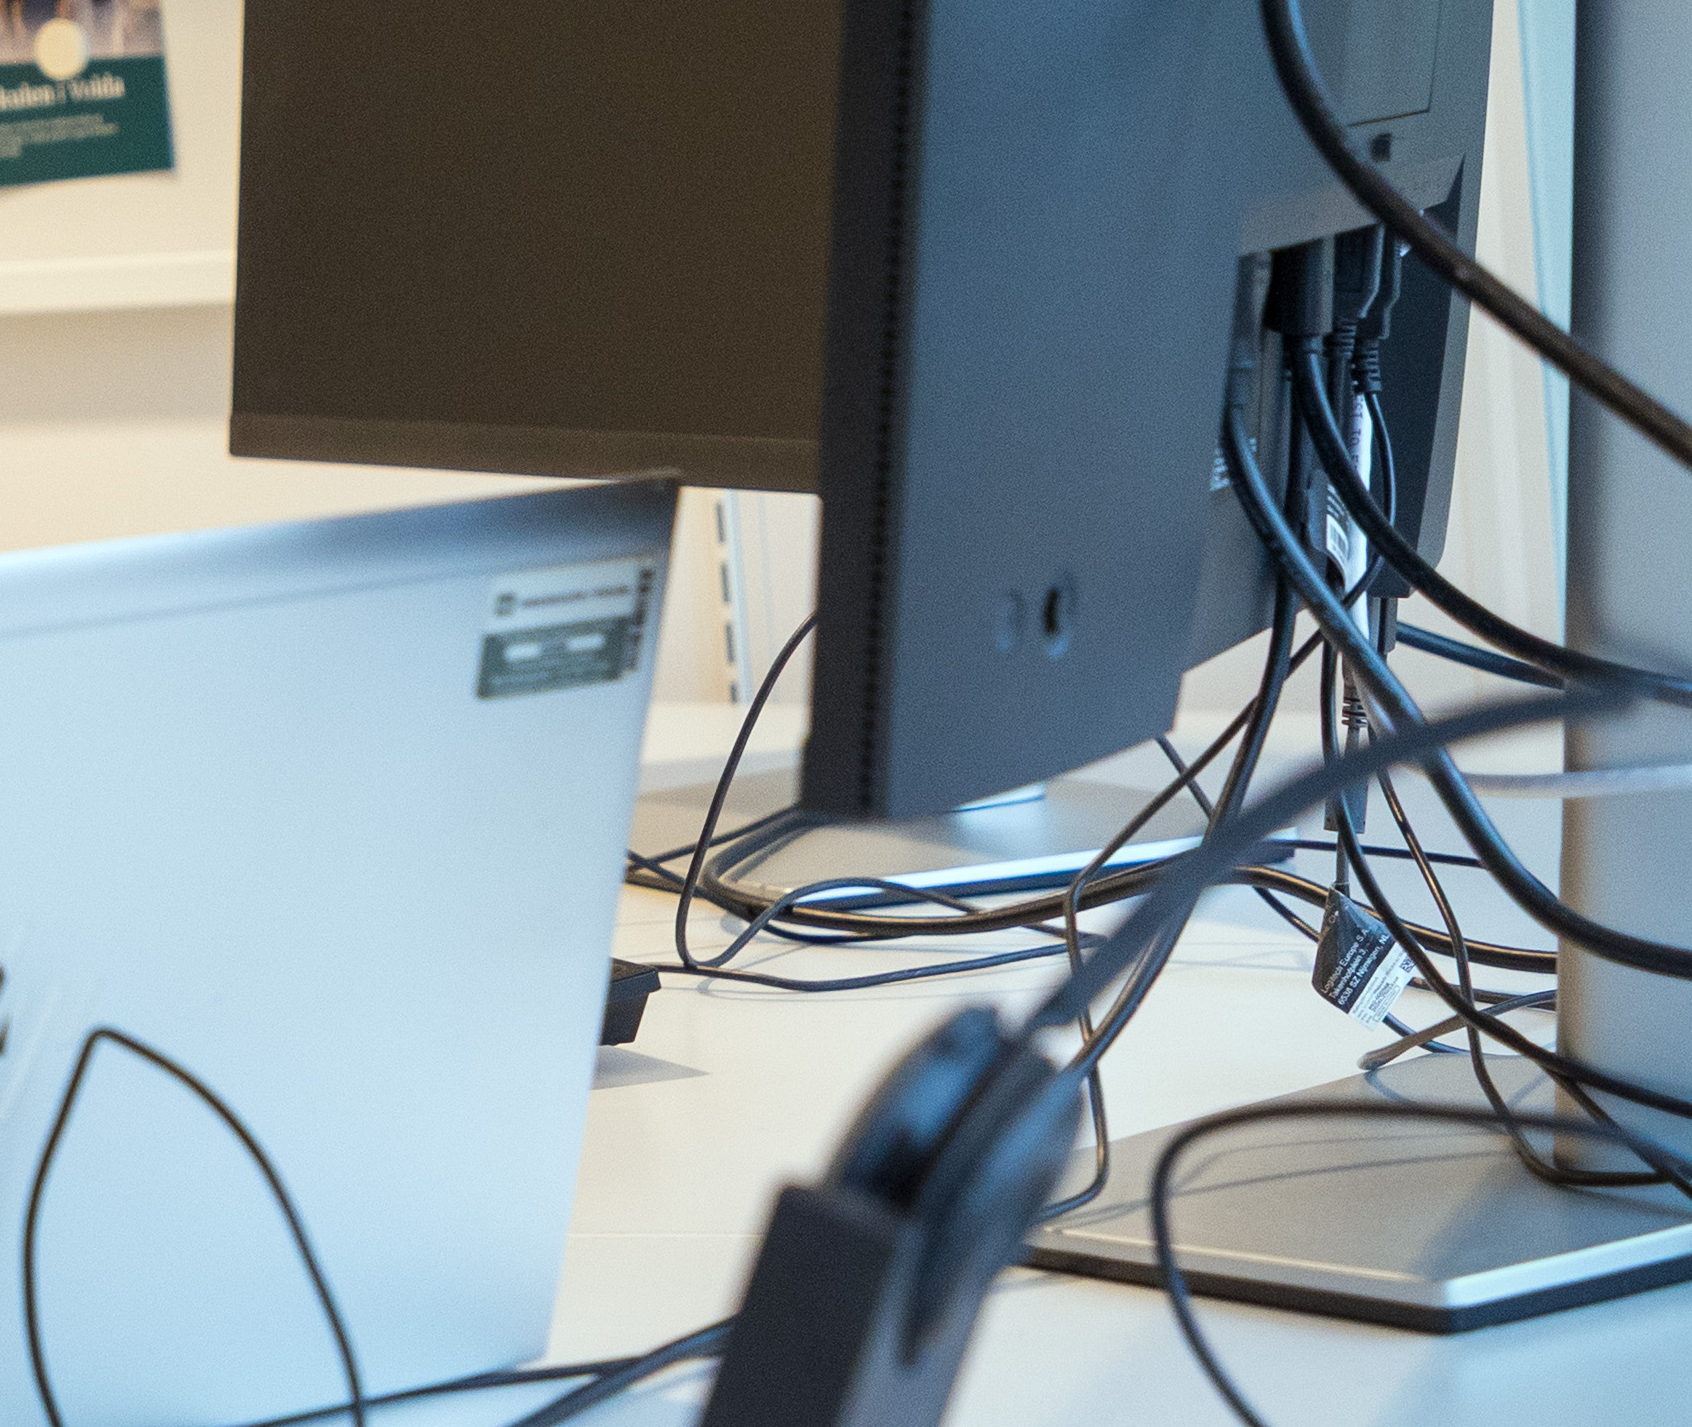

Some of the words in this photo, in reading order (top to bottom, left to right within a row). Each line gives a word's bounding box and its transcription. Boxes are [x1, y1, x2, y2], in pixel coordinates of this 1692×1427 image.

[69, 75, 126, 104] Volda
[1320, 964, 1344, 994] Logitech
[1340, 941, 1360, 967] Europe
[1329, 955, 1362, 999] Takenhofplein
[1337, 986, 1354, 1006] 6538
[1352, 975, 1362, 988] SZ
[1357, 945, 1384, 978] Nijmegen,
[1378, 933, 1391, 946] NL
